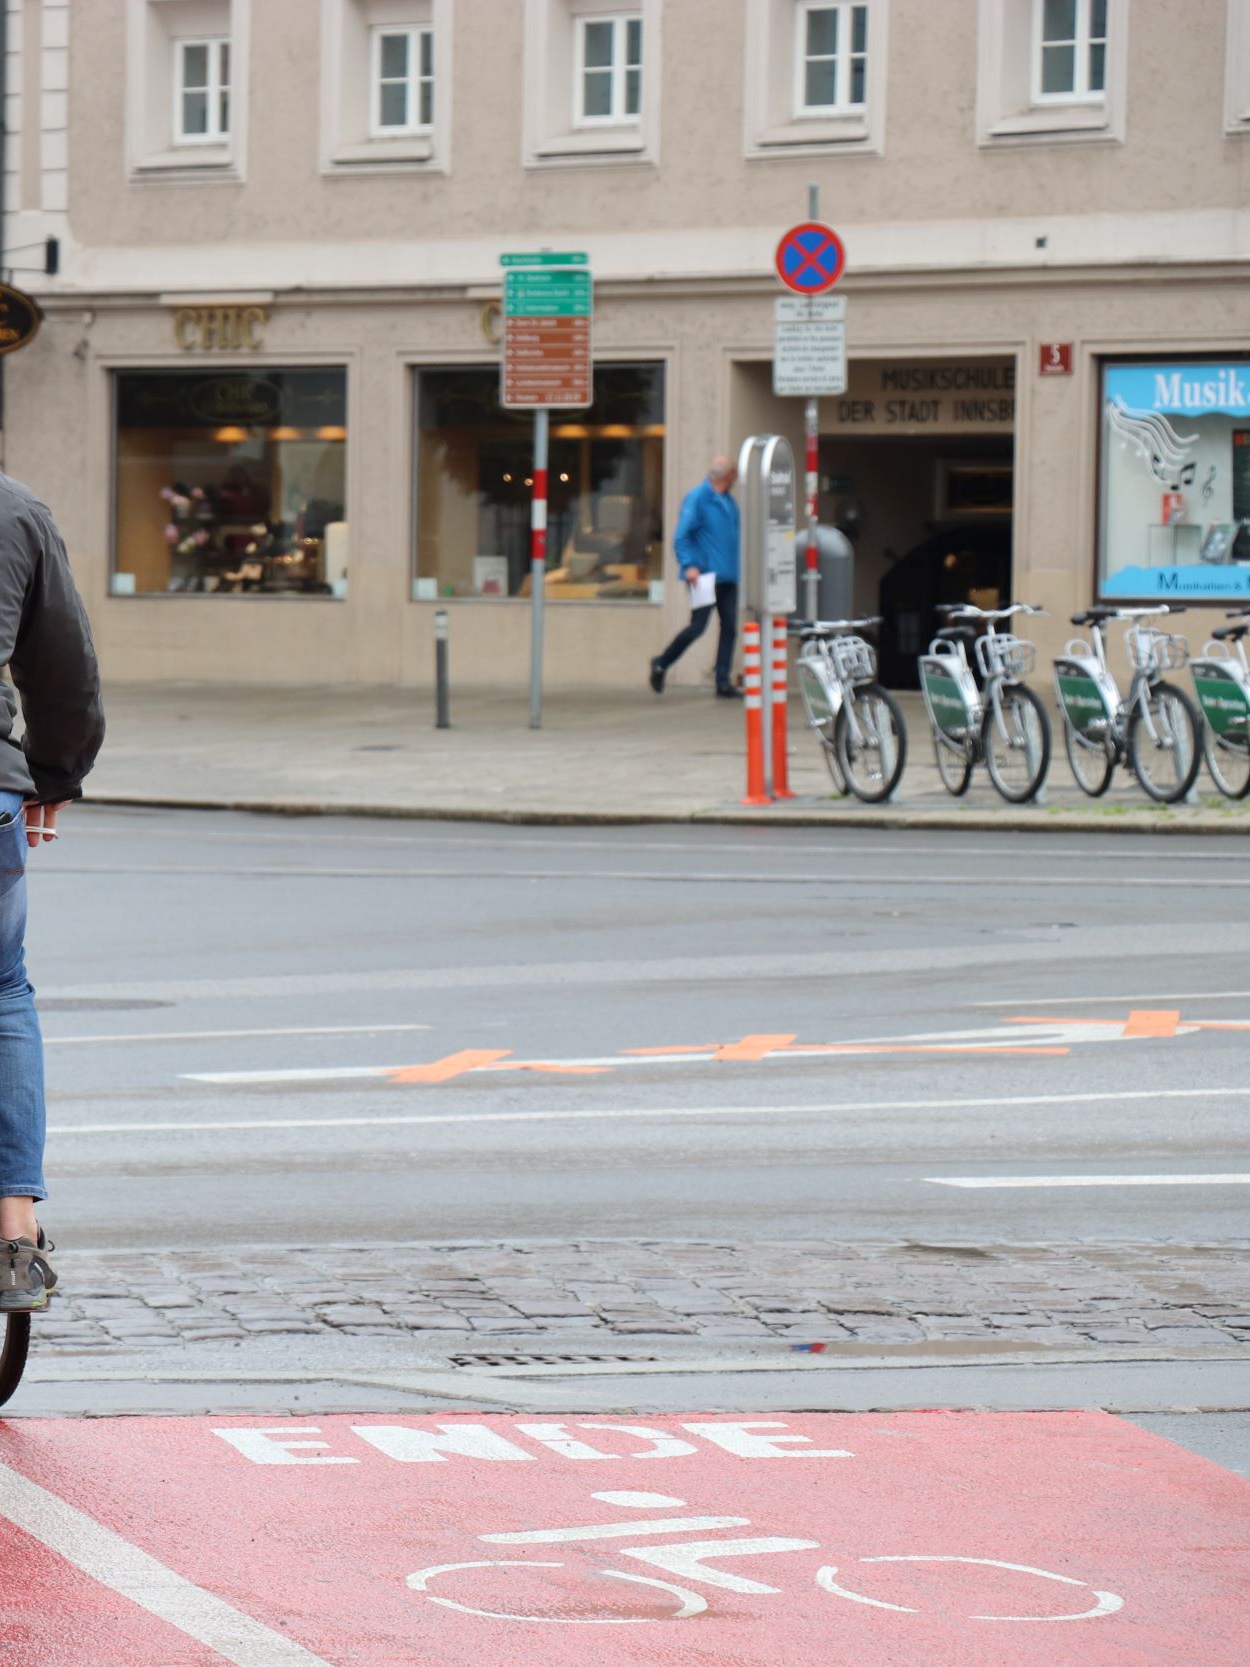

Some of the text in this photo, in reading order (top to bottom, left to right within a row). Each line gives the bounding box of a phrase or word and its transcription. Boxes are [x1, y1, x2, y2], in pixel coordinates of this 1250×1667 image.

[173, 305, 269, 351] CHIC
[882, 367, 1015, 392] MUSIKSCHULE
[1153, 367, 1250, 409] Musik
[837, 398, 1015, 424] DER STADT INNSB
[209, 1421, 857, 1465] ENDE
